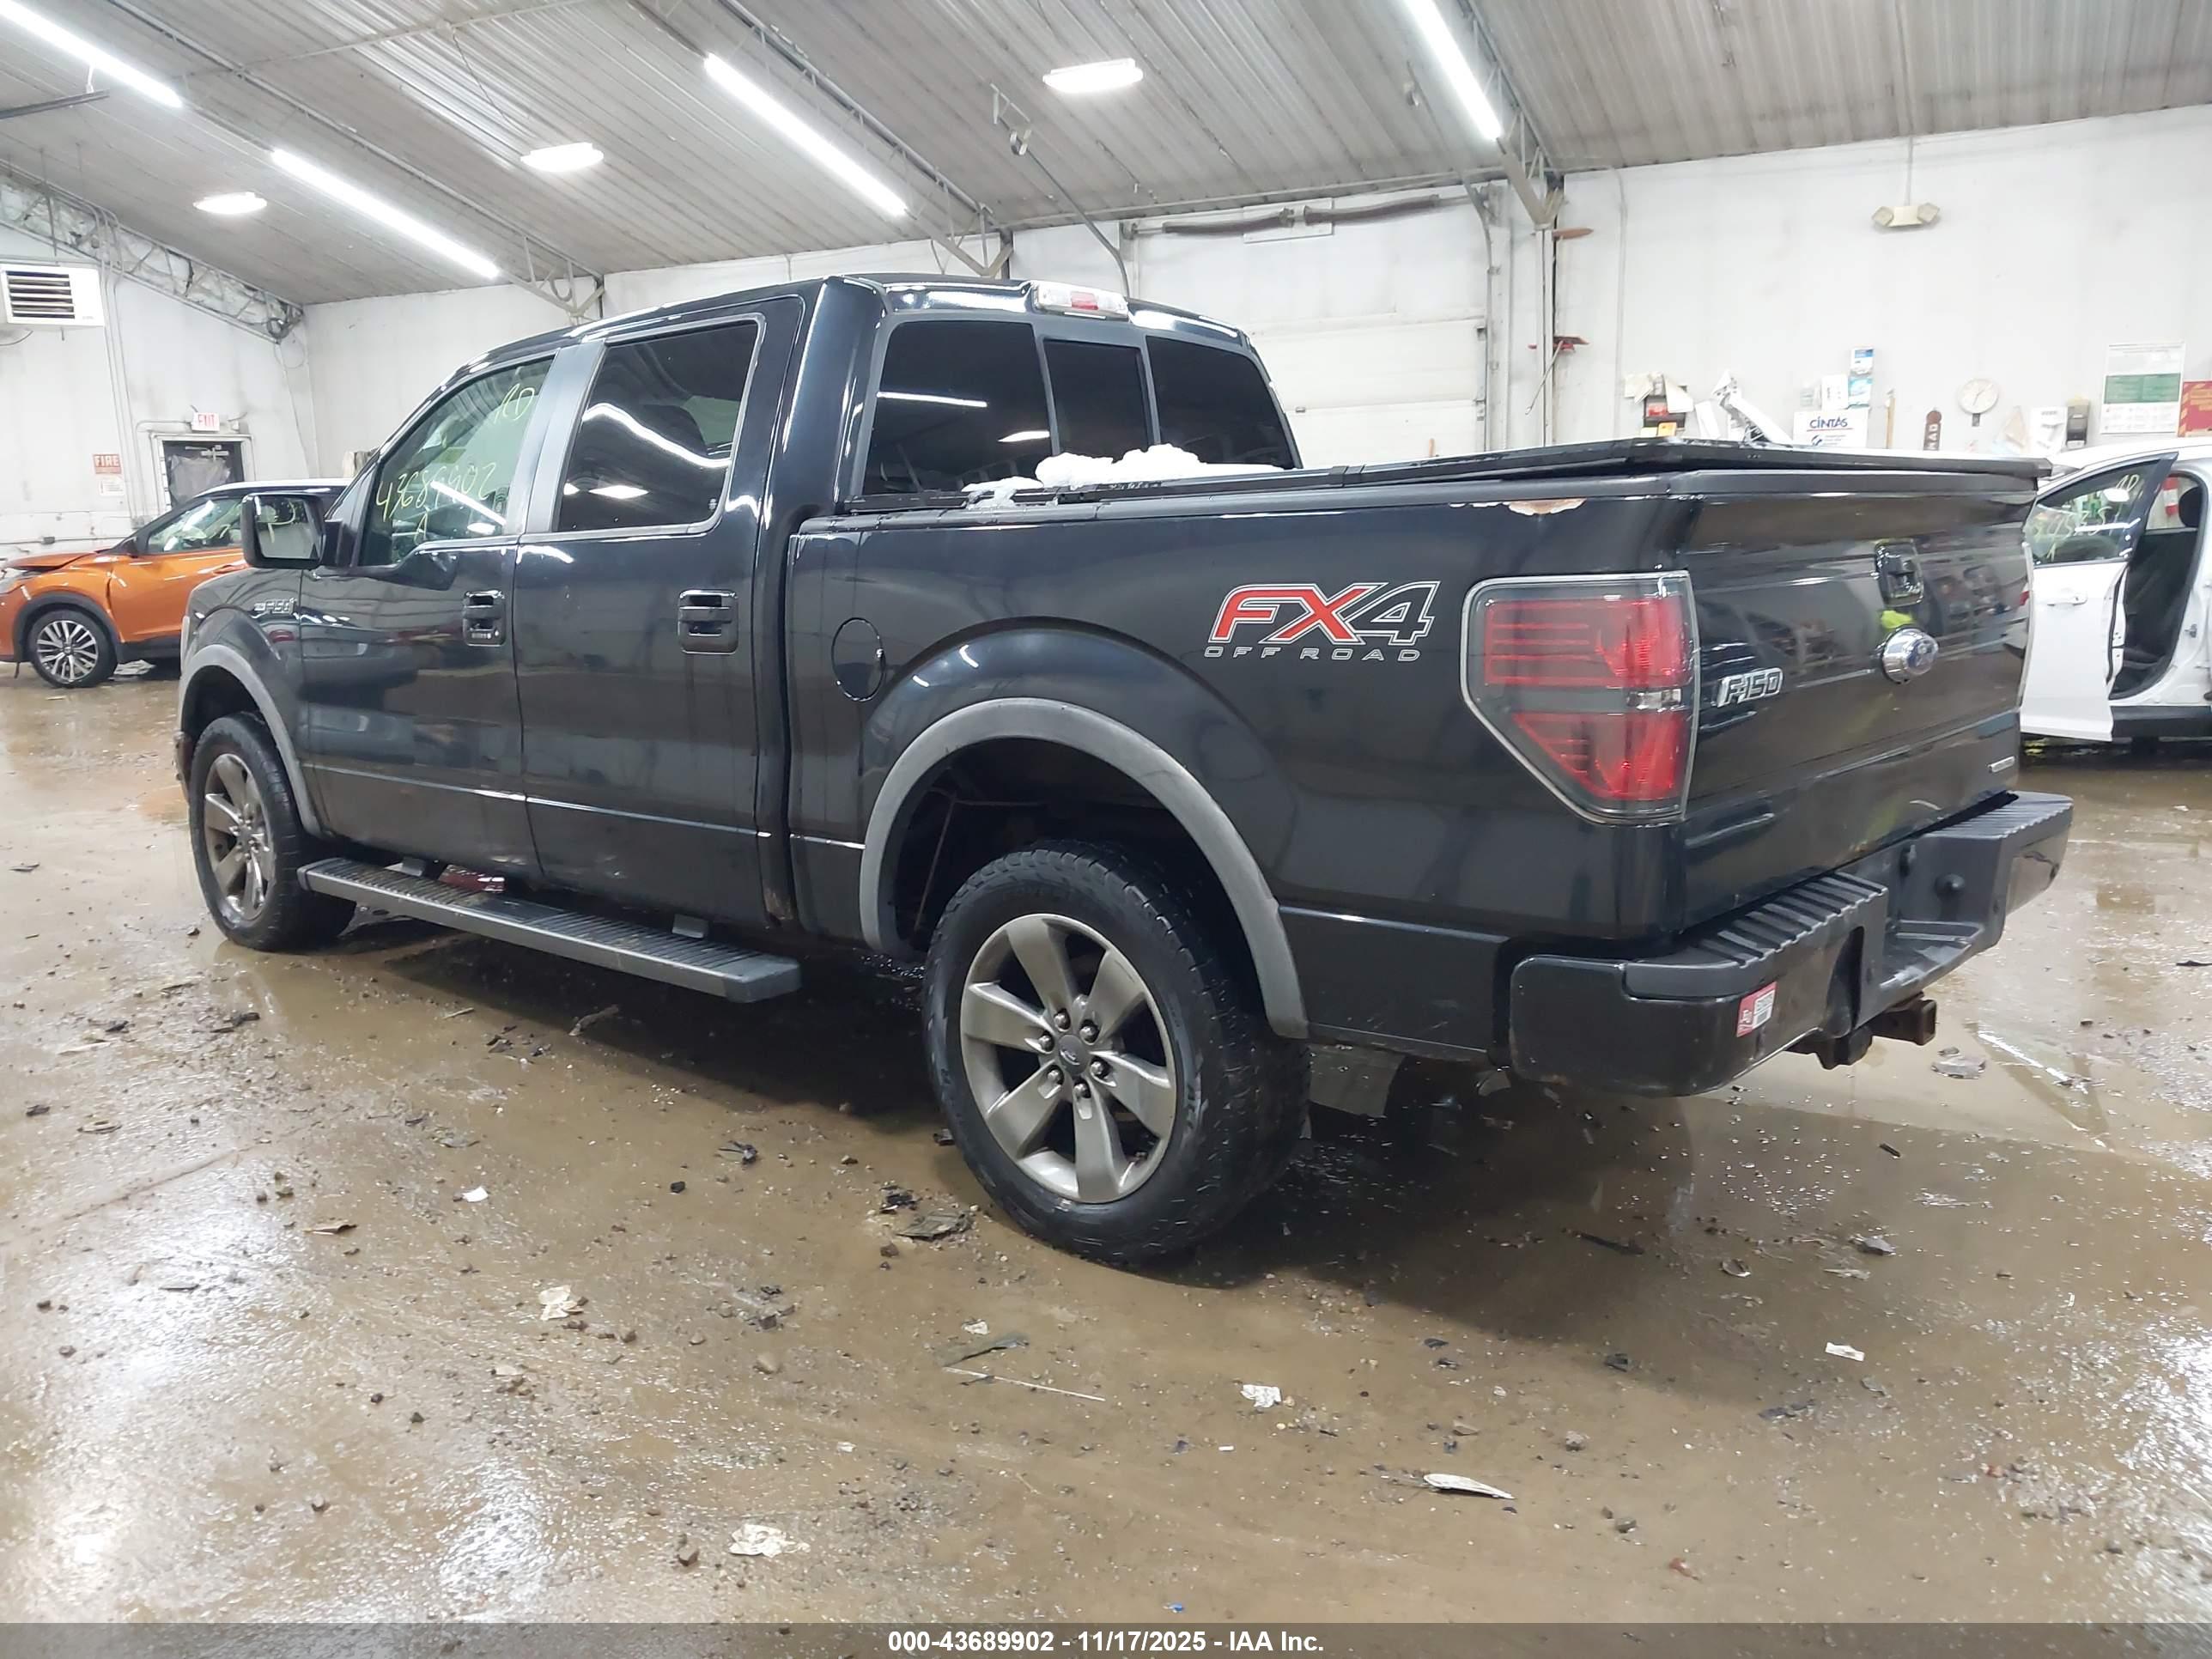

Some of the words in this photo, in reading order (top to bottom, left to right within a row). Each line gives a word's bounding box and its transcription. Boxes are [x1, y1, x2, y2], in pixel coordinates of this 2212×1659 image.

[1809, 416, 1849, 429] CINTAS
[94, 455, 119, 467] FIRE
[1207, 580, 1441, 647] FX4
[1203, 646, 1282, 659] OFF
[1299, 647, 1421, 662] ROAD
